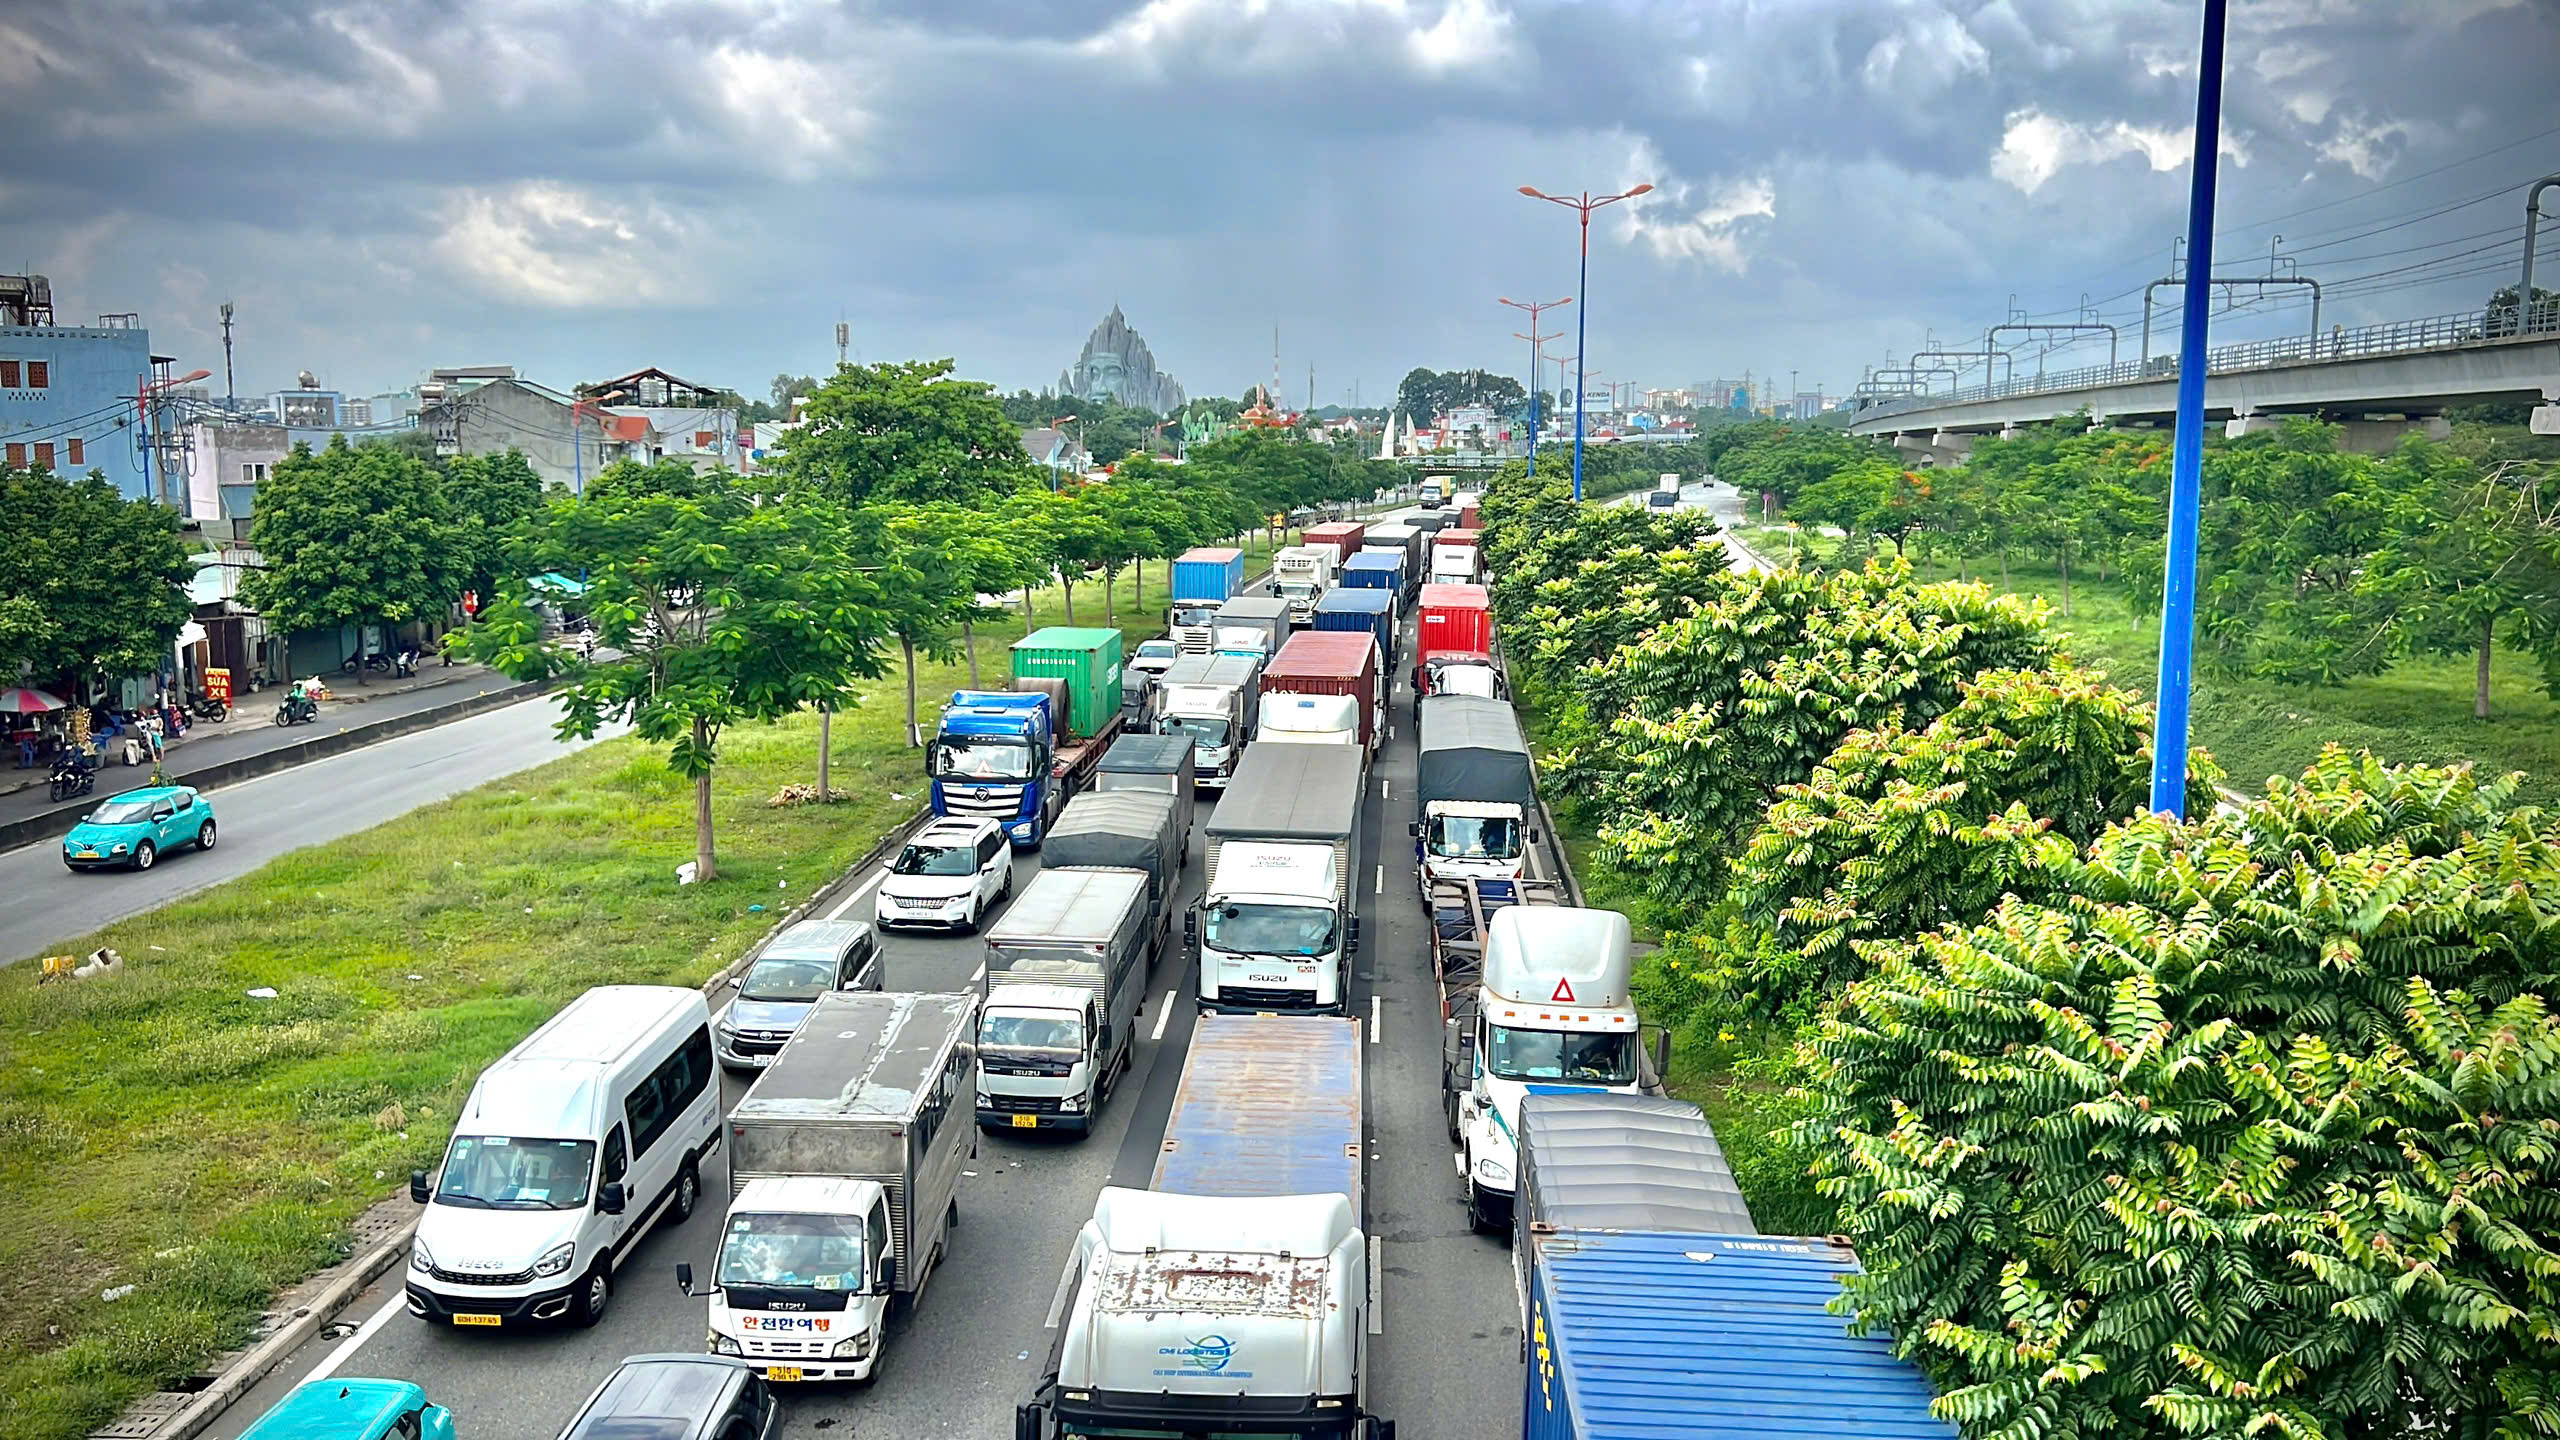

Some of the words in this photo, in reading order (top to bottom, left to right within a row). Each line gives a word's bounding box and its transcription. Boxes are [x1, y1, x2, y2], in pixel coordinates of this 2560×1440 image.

[210, 687, 227, 697] XE
[1249, 974, 1288, 983] ISUZU
[1012, 1069, 1041, 1077] ISUZU
[768, 1301, 807, 1311] ISUZU
